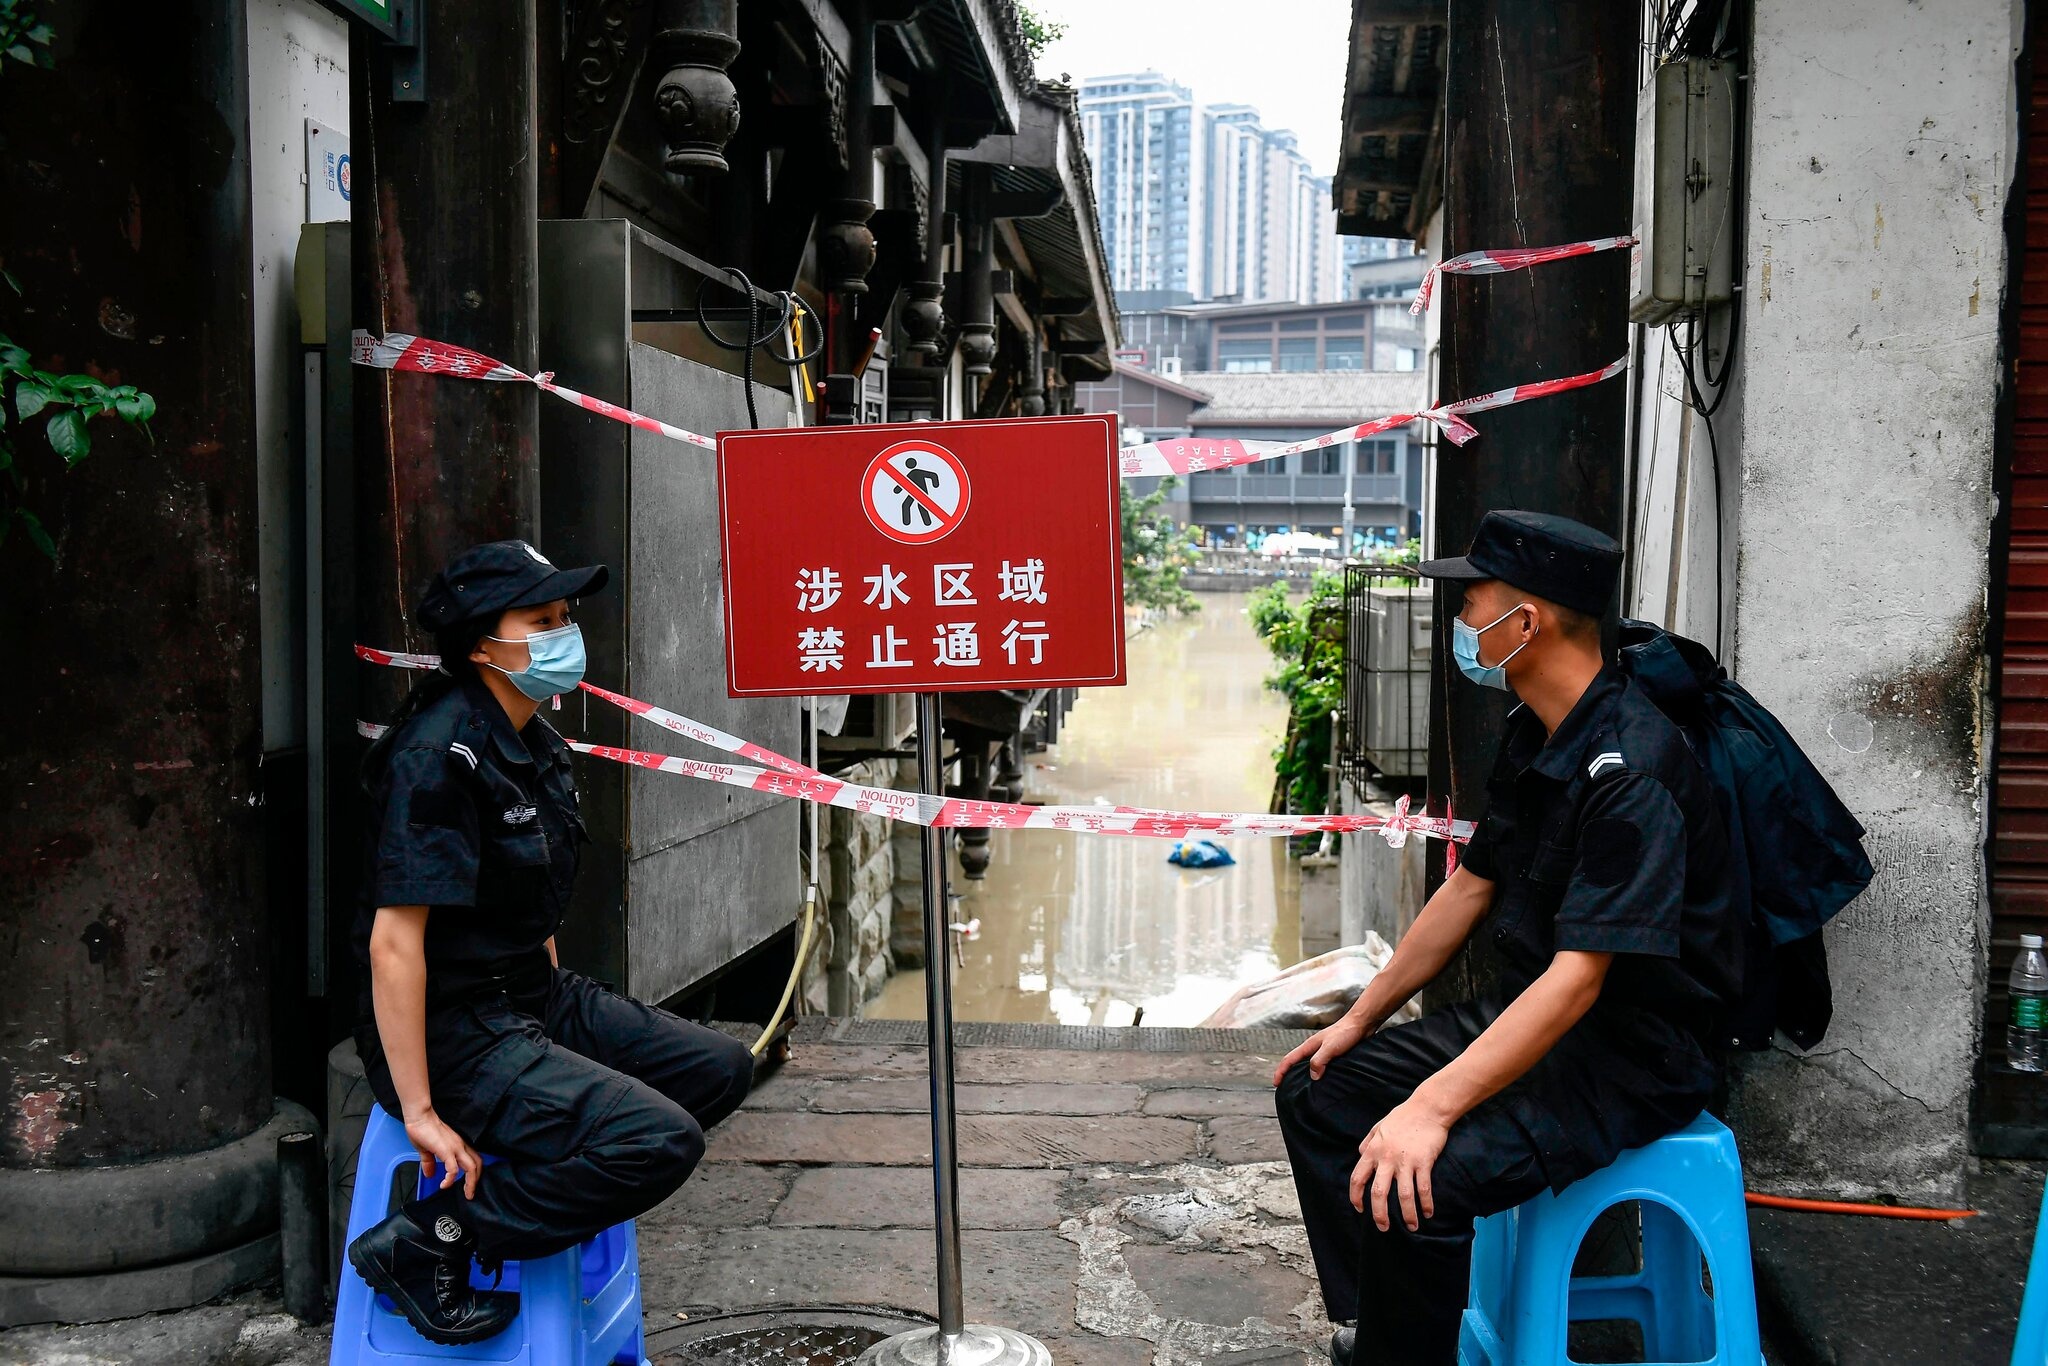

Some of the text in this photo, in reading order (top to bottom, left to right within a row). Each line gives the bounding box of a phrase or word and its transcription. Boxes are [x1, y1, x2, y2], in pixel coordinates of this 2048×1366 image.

[794, 558, 1048, 613] 涉水区域
[797, 618, 1050, 673] 禁止通行
[665, 718, 715, 742] CAUTION
[601, 748, 650, 763] SAFE
[681, 760, 734, 776] CAUTION
[771, 775, 824, 792] SAFE
[860, 790, 915, 807] CAUTION
[959, 802, 1017, 815] SAFE
[952, 814, 1007, 828] 安全
